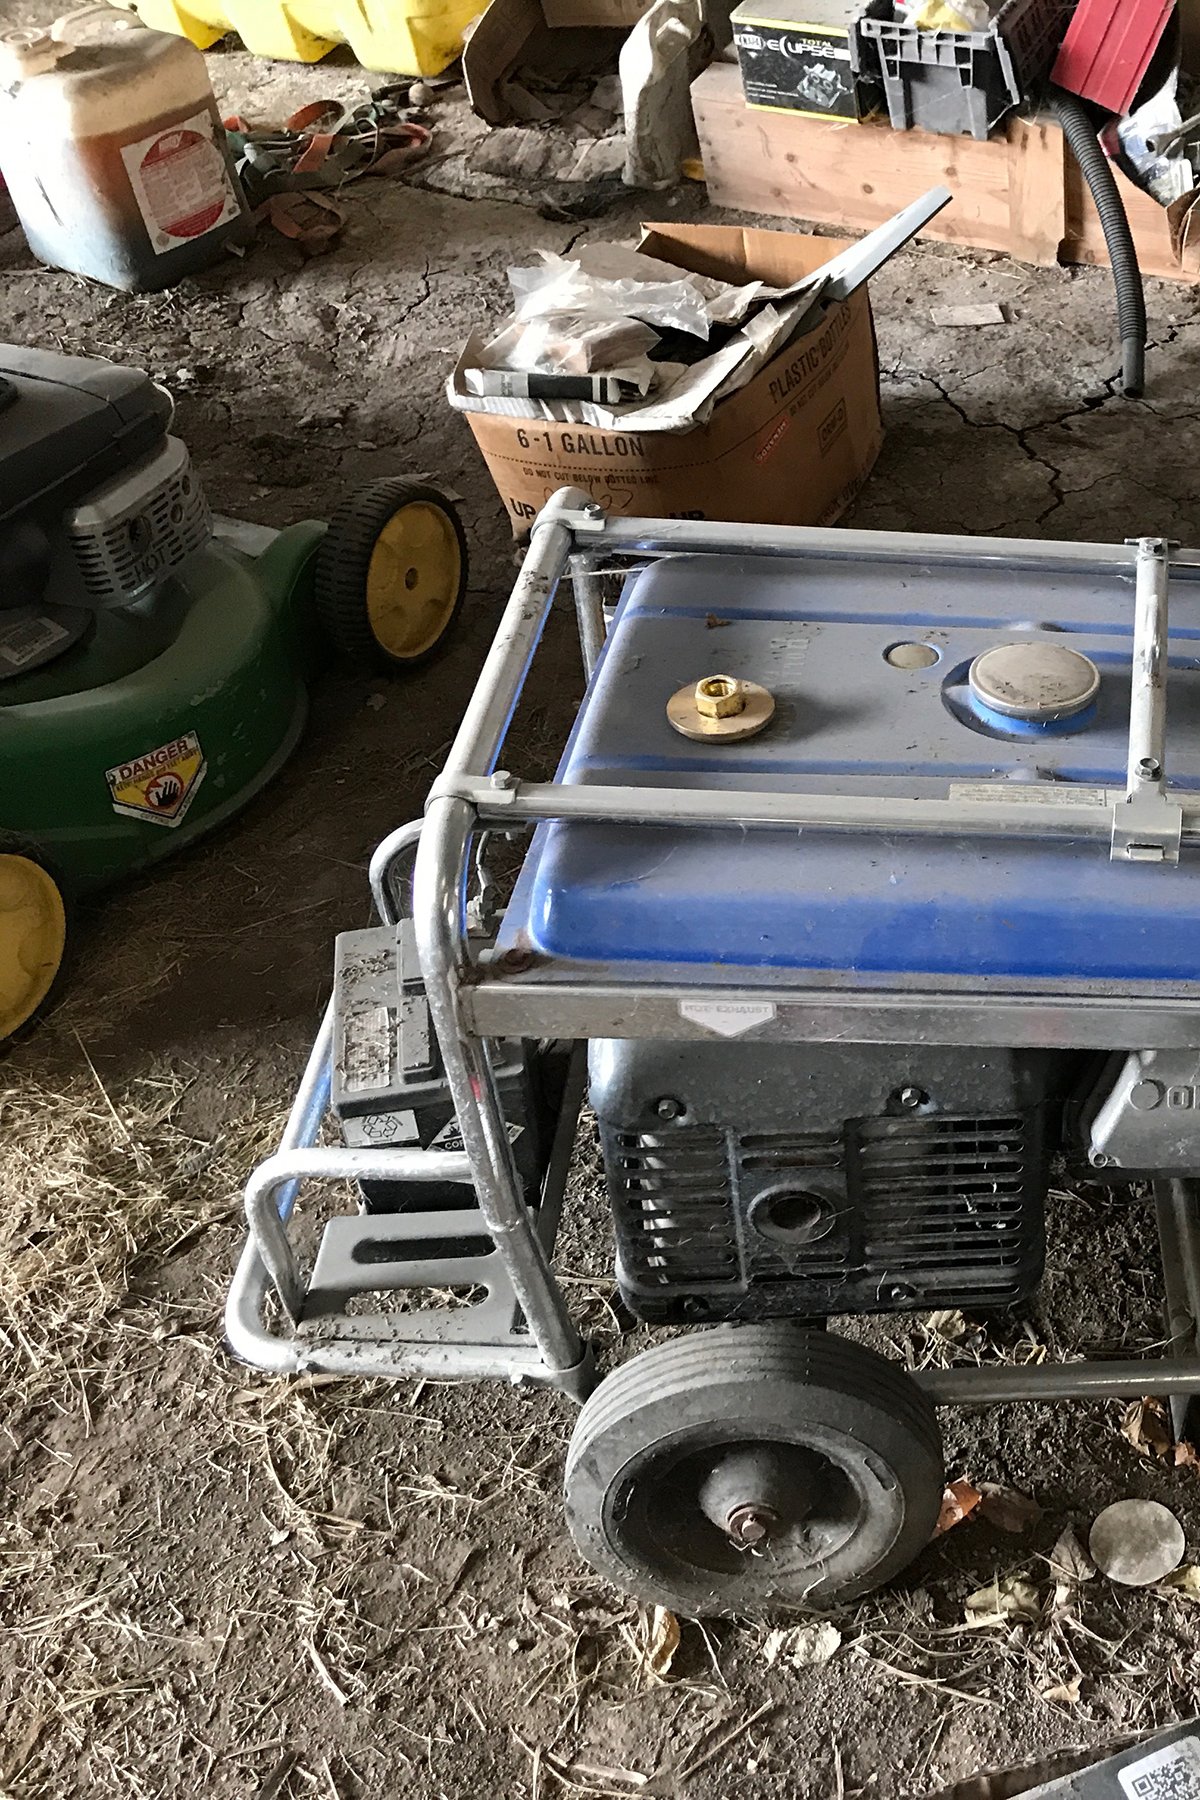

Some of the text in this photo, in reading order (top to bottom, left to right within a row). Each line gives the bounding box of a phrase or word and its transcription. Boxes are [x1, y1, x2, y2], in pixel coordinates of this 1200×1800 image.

[768, 346, 819, 405] PLASTIC
[819, 303, 852, 359] BOTTLES
[561, 432, 645, 457] GALLON
[535, 469, 551, 479] NOT
[553, 471, 570, 481] CUT
[573, 473, 601, 484] BELOW
[119, 740, 188, 780] DANGER
